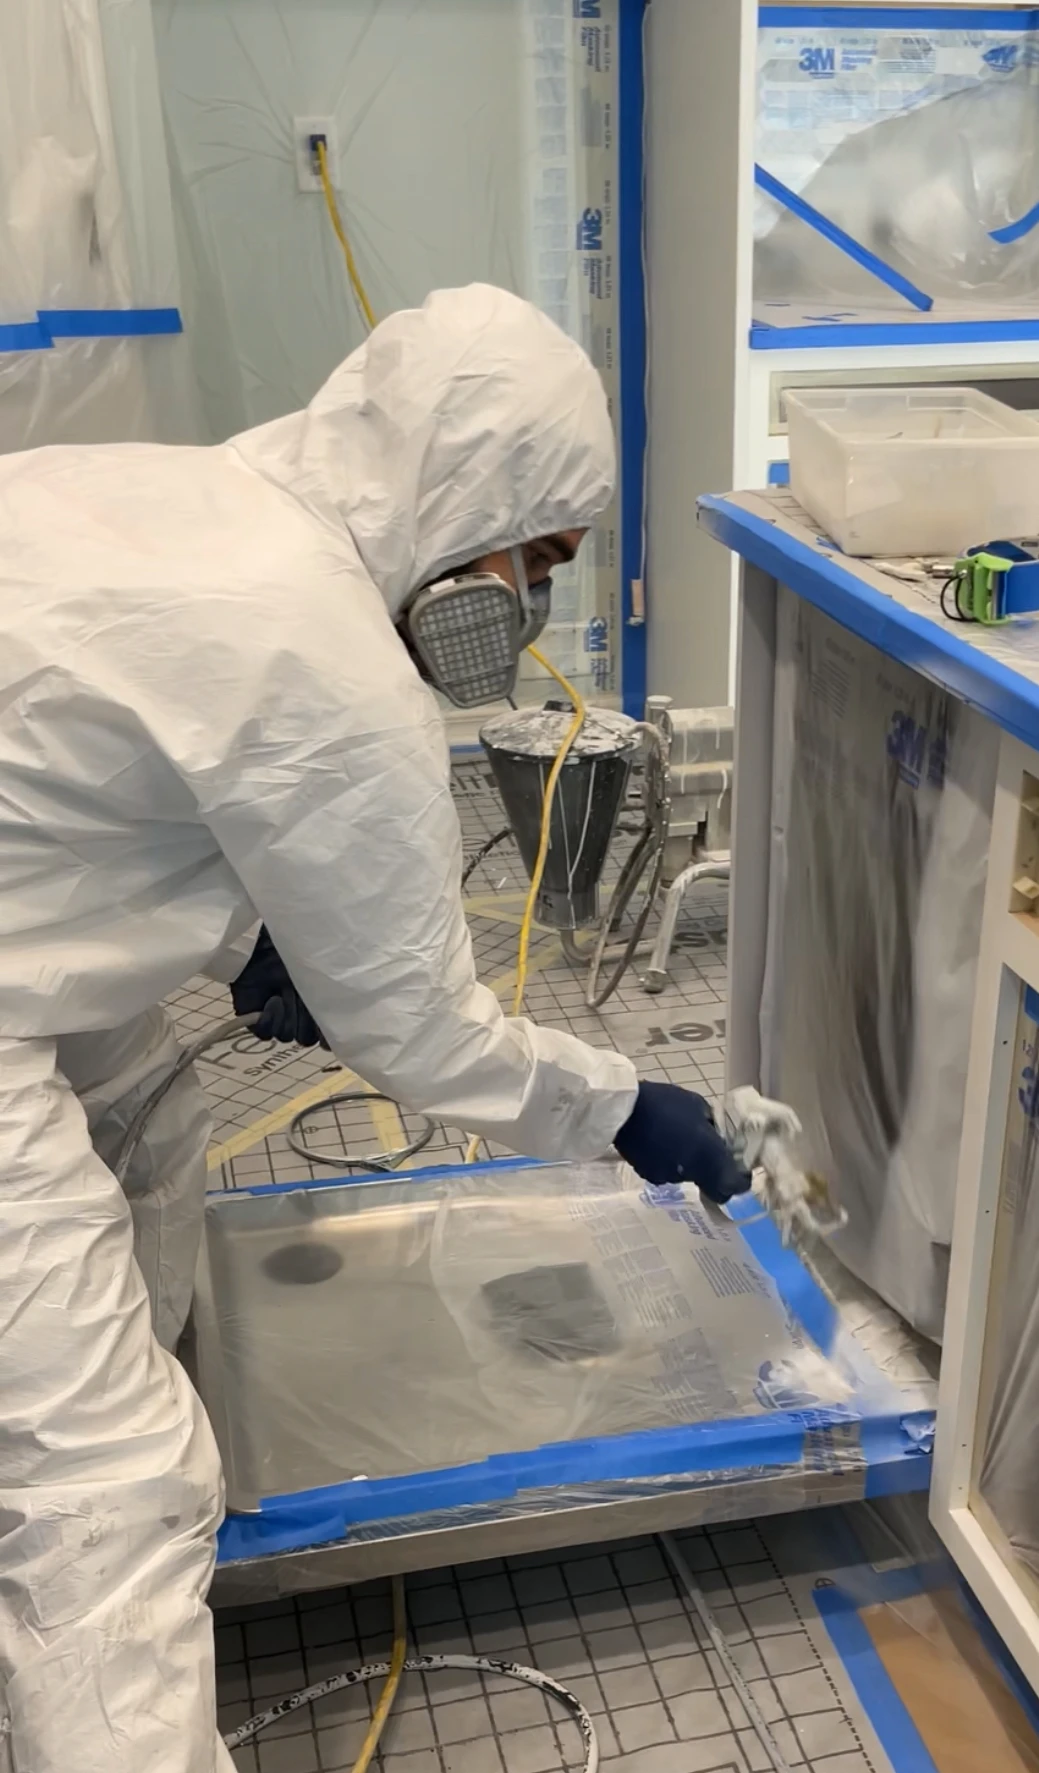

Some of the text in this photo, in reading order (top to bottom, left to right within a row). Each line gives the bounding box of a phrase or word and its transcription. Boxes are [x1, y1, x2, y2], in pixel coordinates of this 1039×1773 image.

[581, 0, 601, 18] M
[799, 48, 835, 71] 3M
[582, 208, 602, 250] 3M
[589, 616, 608, 652] 3M
